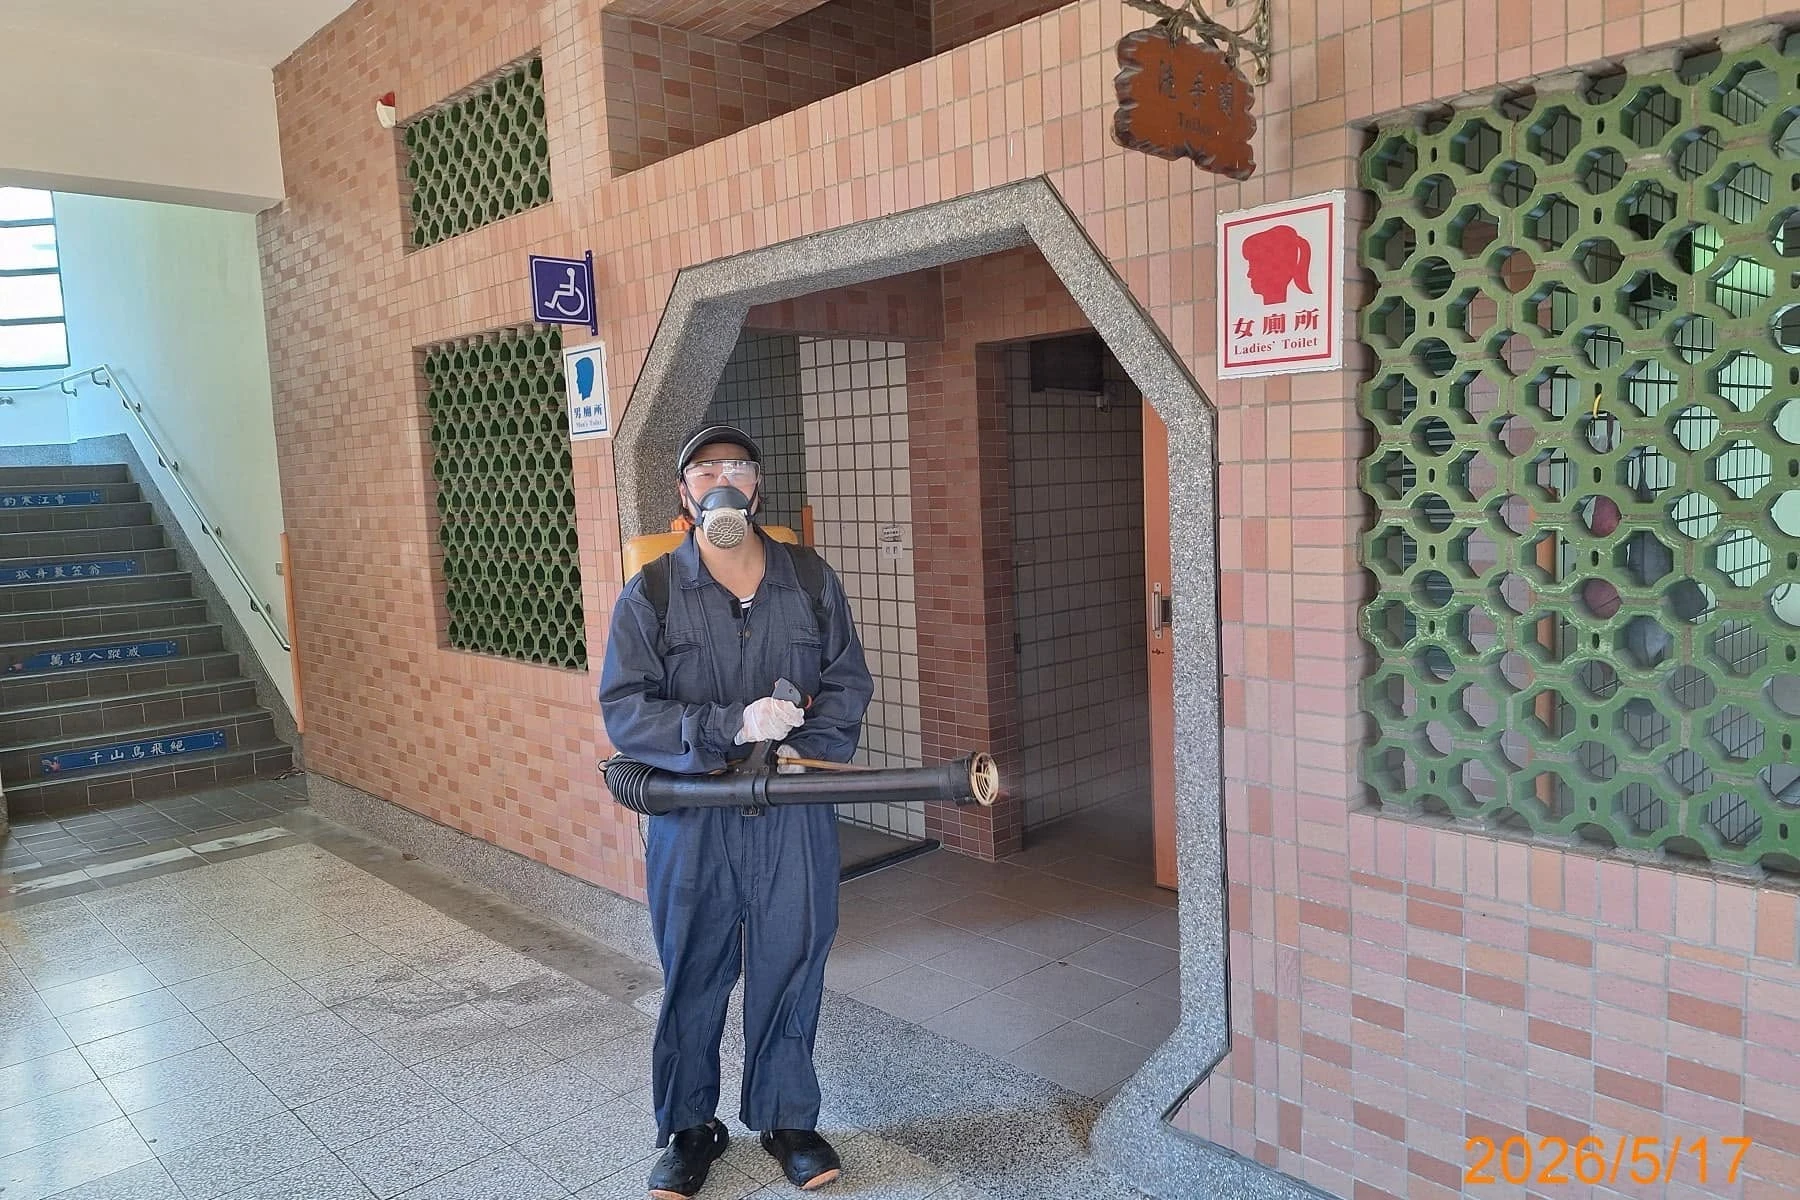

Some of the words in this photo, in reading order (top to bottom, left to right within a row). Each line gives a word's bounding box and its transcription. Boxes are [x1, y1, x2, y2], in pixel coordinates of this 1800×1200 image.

[1232, 308, 1319, 339] 女廁所
[1234, 341, 1275, 355] Ladies'
[1281, 337, 1318, 350] Toilet
[574, 403, 602, 419] 男廁所
